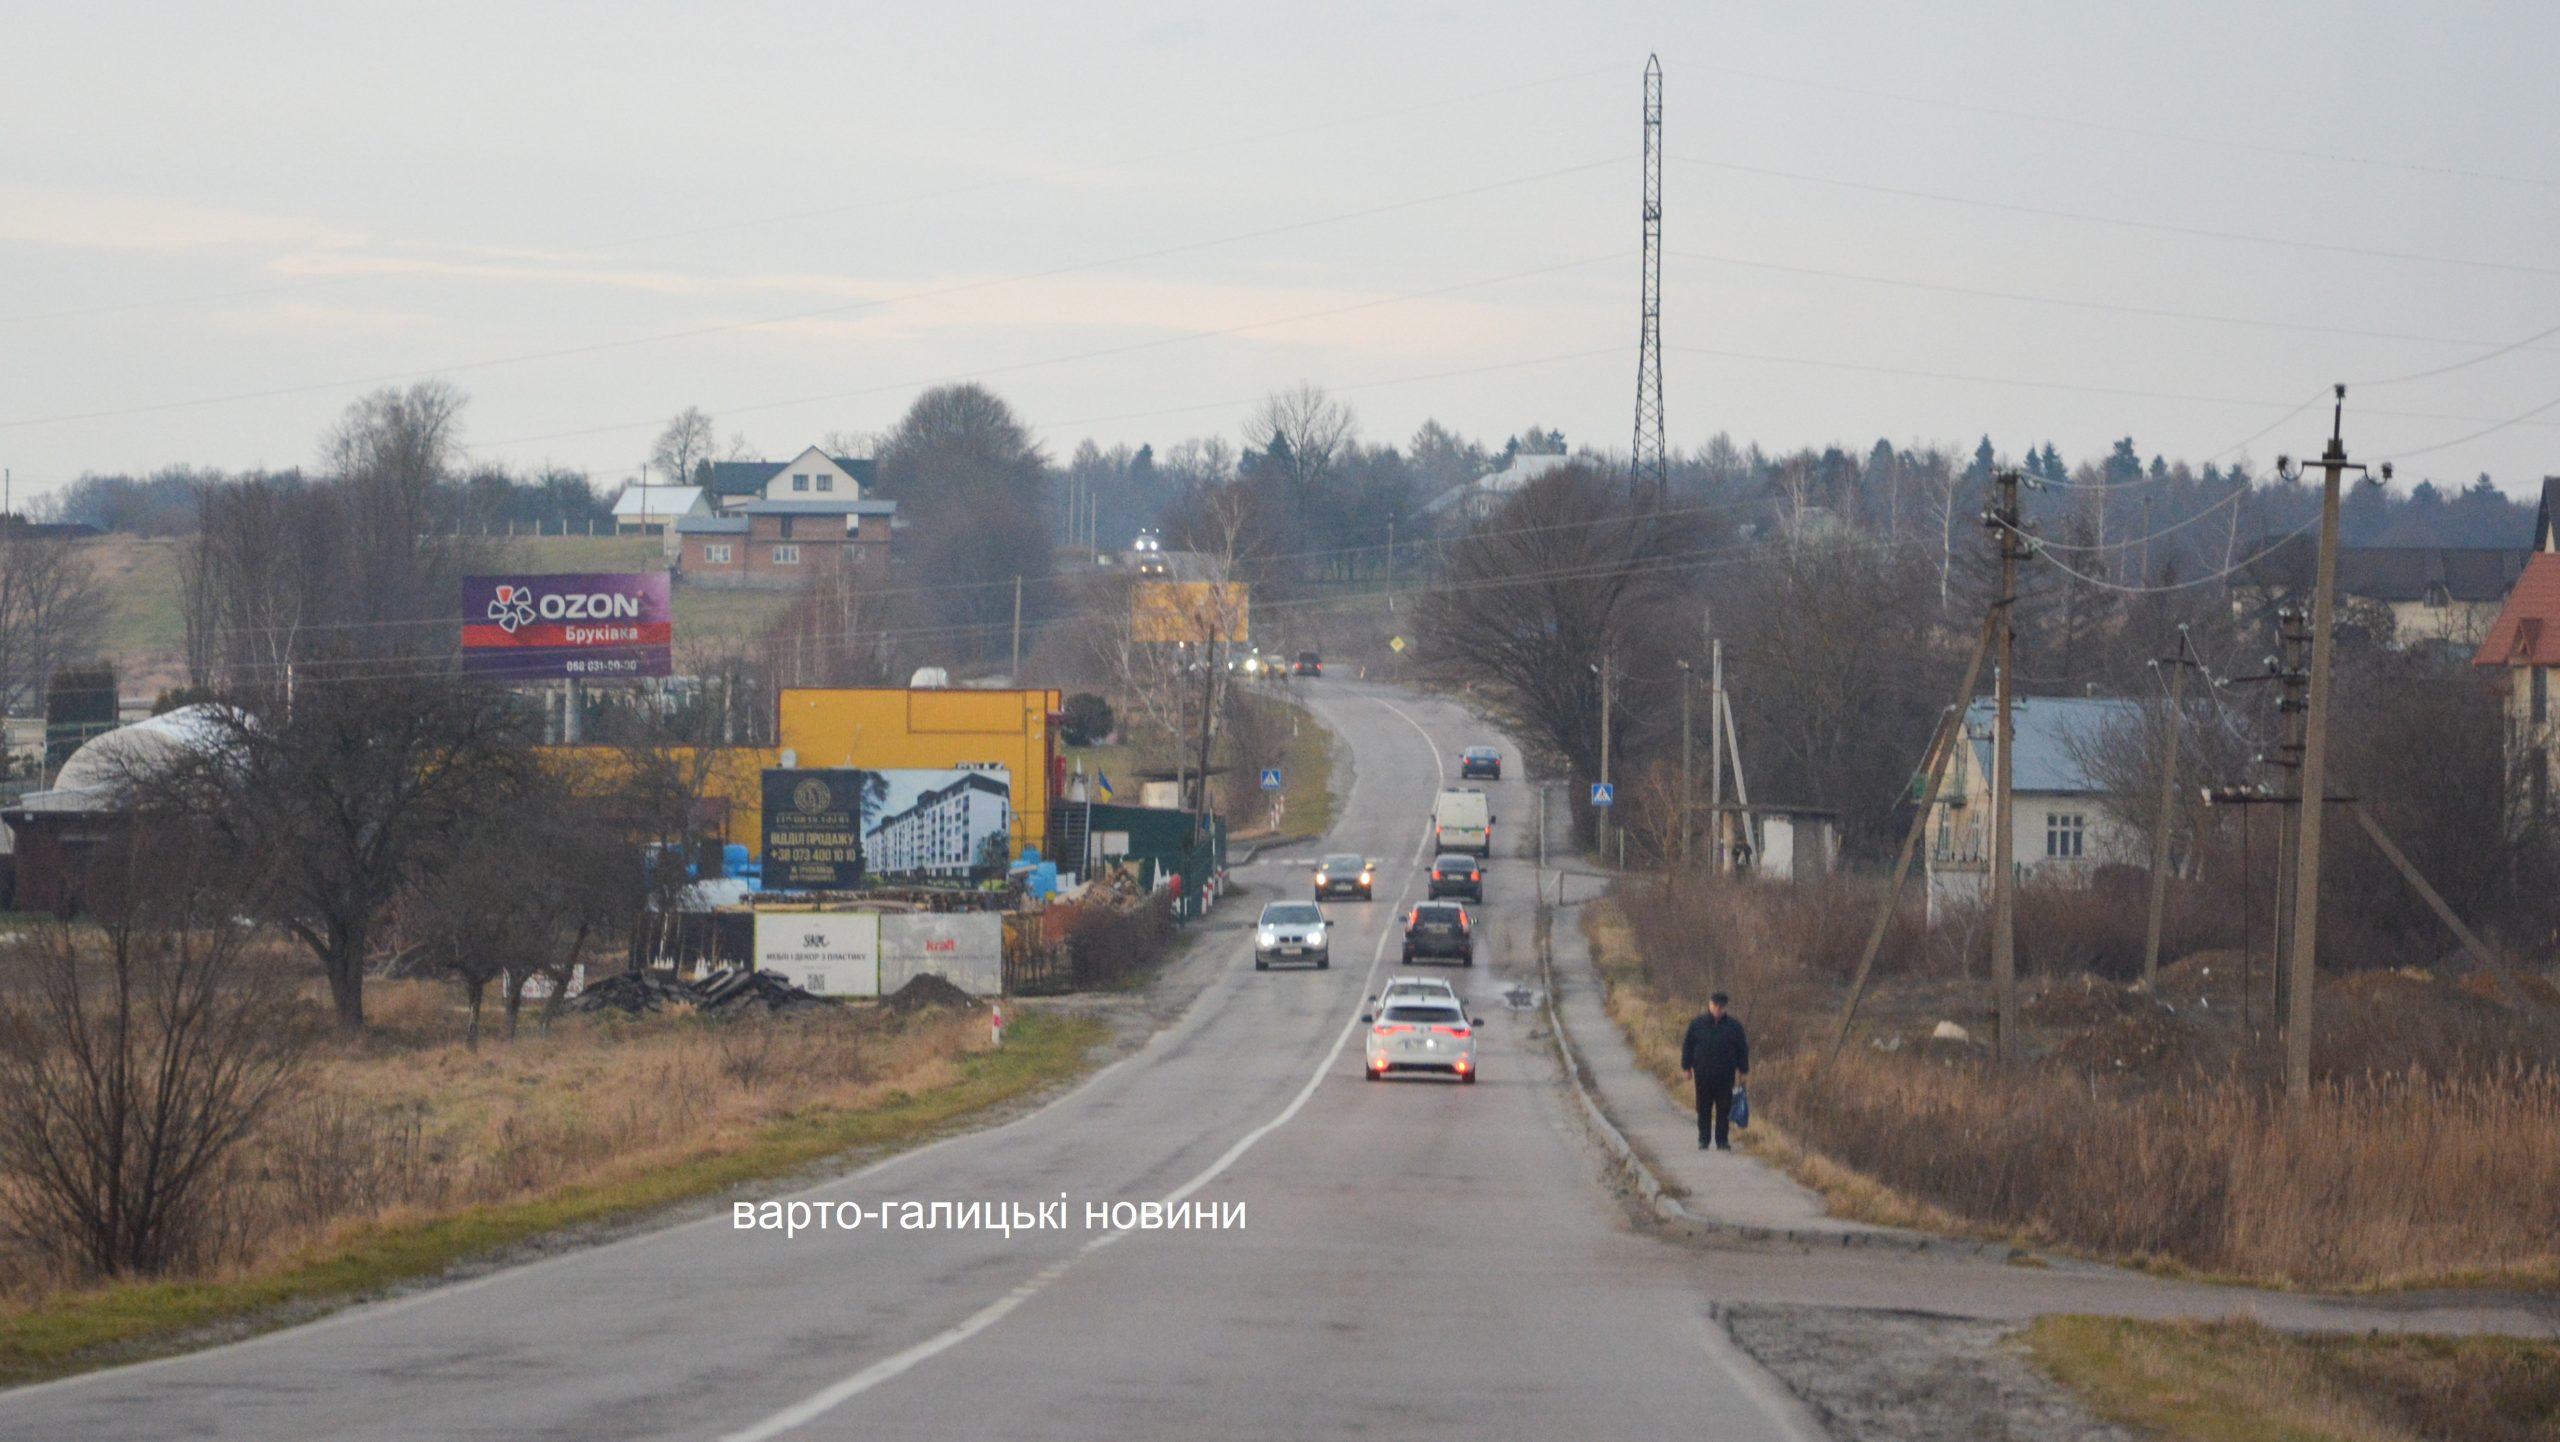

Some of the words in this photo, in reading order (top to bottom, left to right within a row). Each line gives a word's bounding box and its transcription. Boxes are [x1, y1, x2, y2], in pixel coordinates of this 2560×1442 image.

[539, 593, 638, 619] OZON
[565, 625, 638, 644] Бруківка
[770, 831, 805, 846] ВІДДІЛ
[806, 831, 855, 846] ПРОДАЖУ
[769, 848, 791, 861] +38
[792, 848, 811, 862] 073
[812, 848, 832, 862] 400
[833, 848, 844, 862] 10
[846, 848, 857, 862] 10
[795, 953, 819, 962] ДЕКОР
[827, 953, 867, 961] ПЛАСТИКУ
